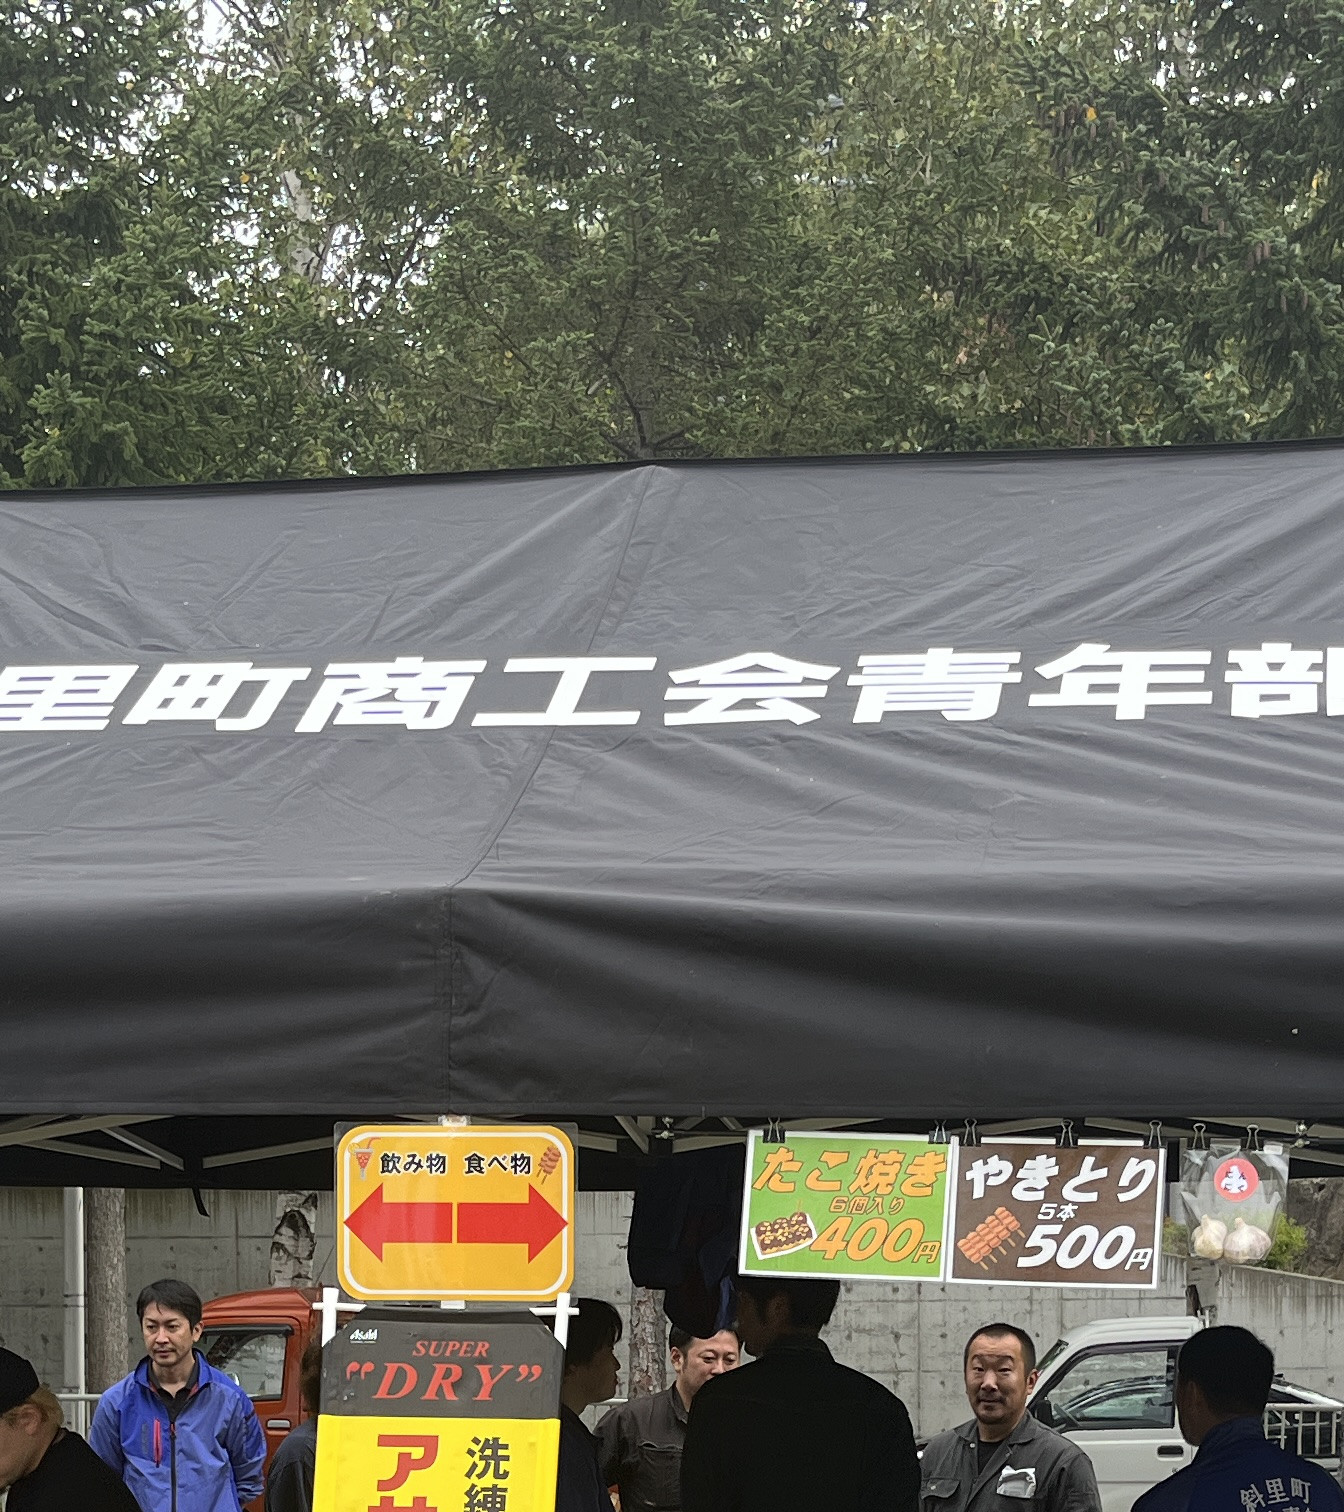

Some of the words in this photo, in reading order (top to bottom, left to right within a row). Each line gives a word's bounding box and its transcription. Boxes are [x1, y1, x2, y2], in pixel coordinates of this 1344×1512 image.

[380, 1152, 447, 1174] 飲み物
[464, 1152, 531, 1175] 食べ物
[752, 1148, 947, 1195] たこ焼き
[965, 1153, 1156, 1203] やきとり
[828, 1196, 904, 1216] 6個入り
[1037, 1202, 1078, 1222] 5本
[808, 1217, 940, 1264] 400円
[1016, 1223, 1151, 1271] 500円
[413, 1340, 490, 1357] SUPER
